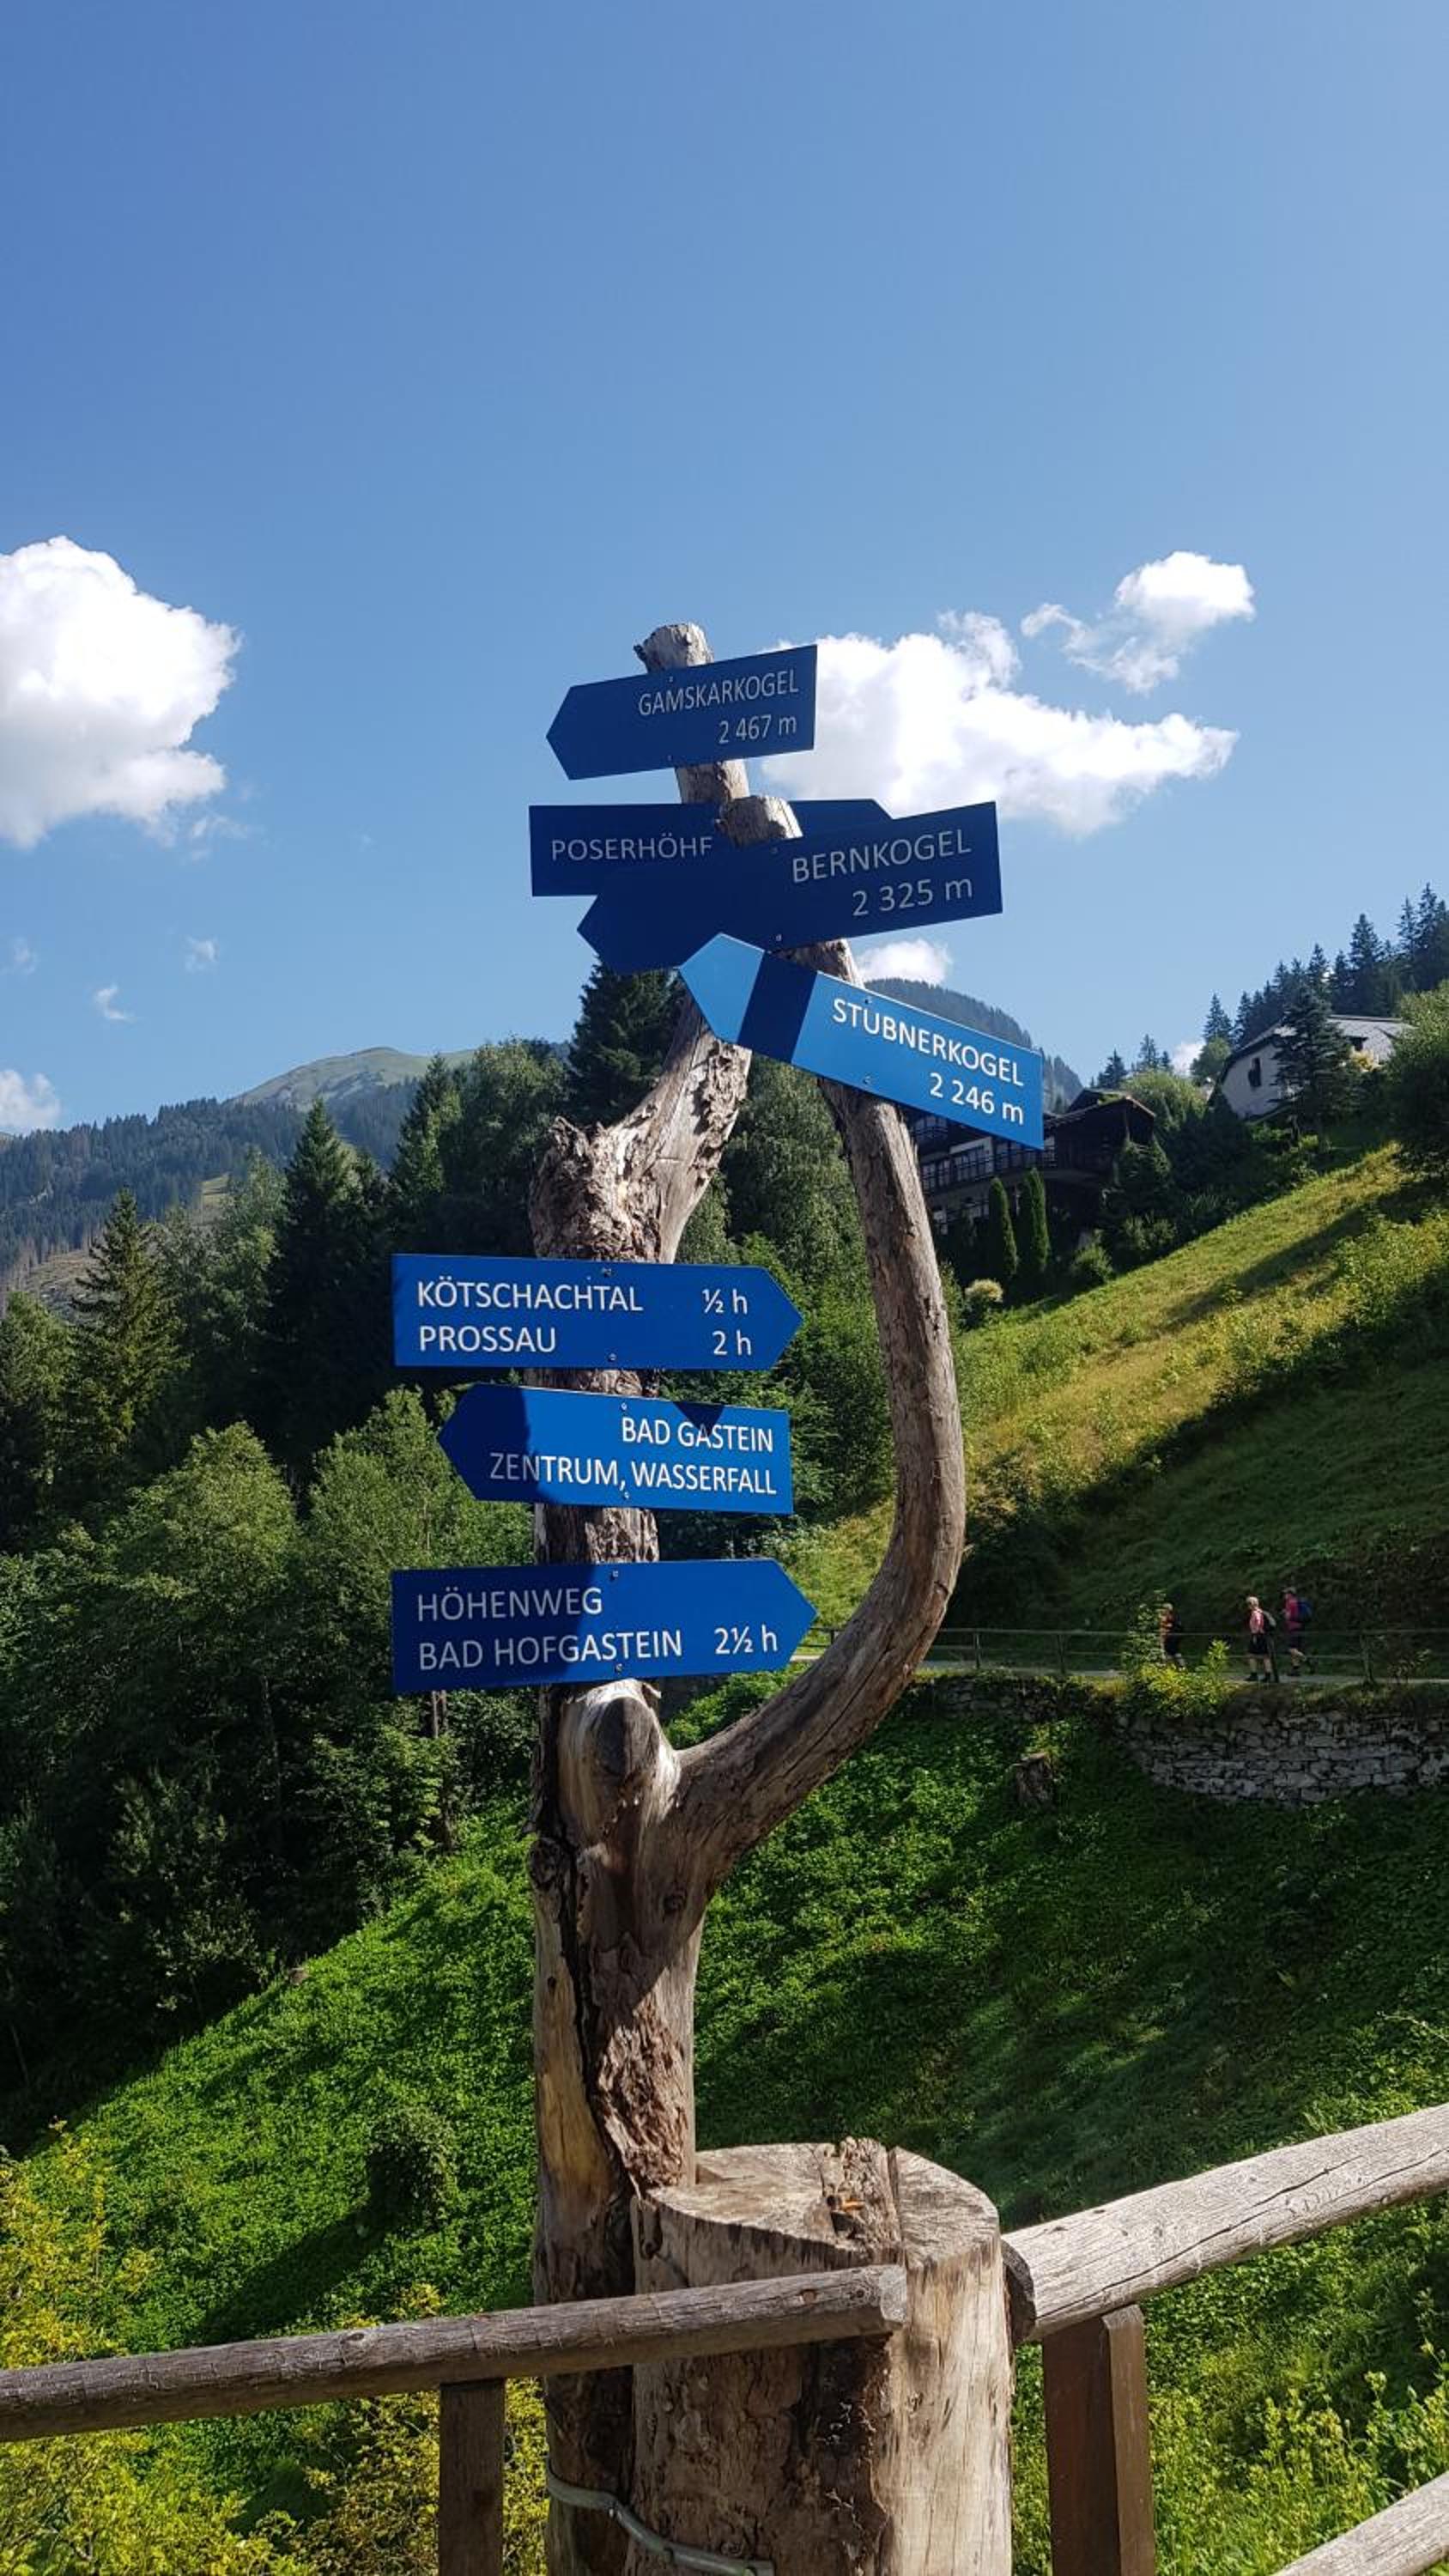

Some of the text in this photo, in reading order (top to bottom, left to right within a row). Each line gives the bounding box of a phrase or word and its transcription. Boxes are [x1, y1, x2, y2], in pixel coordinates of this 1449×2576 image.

[638, 669, 799, 716] GAMSKARKOGEL
[718, 714, 797, 744] 2 467 m
[791, 829, 972, 884] BERNKOGEL
[852, 878, 973, 916] 2 325 m
[832, 998, 1025, 1087] STUBNERKOGEL
[930, 1072, 1024, 1125] 2 246 m
[417, 1276, 644, 1312] KÖTSCHACHTAL
[732, 1290, 748, 1315] h
[419, 1326, 752, 1356] PROSSAU 2 h
[621, 1417, 773, 1453] BAD GASTEIN
[489, 1453, 777, 1495] ZENTRUM, WASSERFALL
[417, 1587, 602, 1622] HÖHENWEG
[419, 1641, 483, 1671] BAD
[494, 1630, 682, 1667] HOFGASTEIN
[761, 1624, 778, 1653] h
